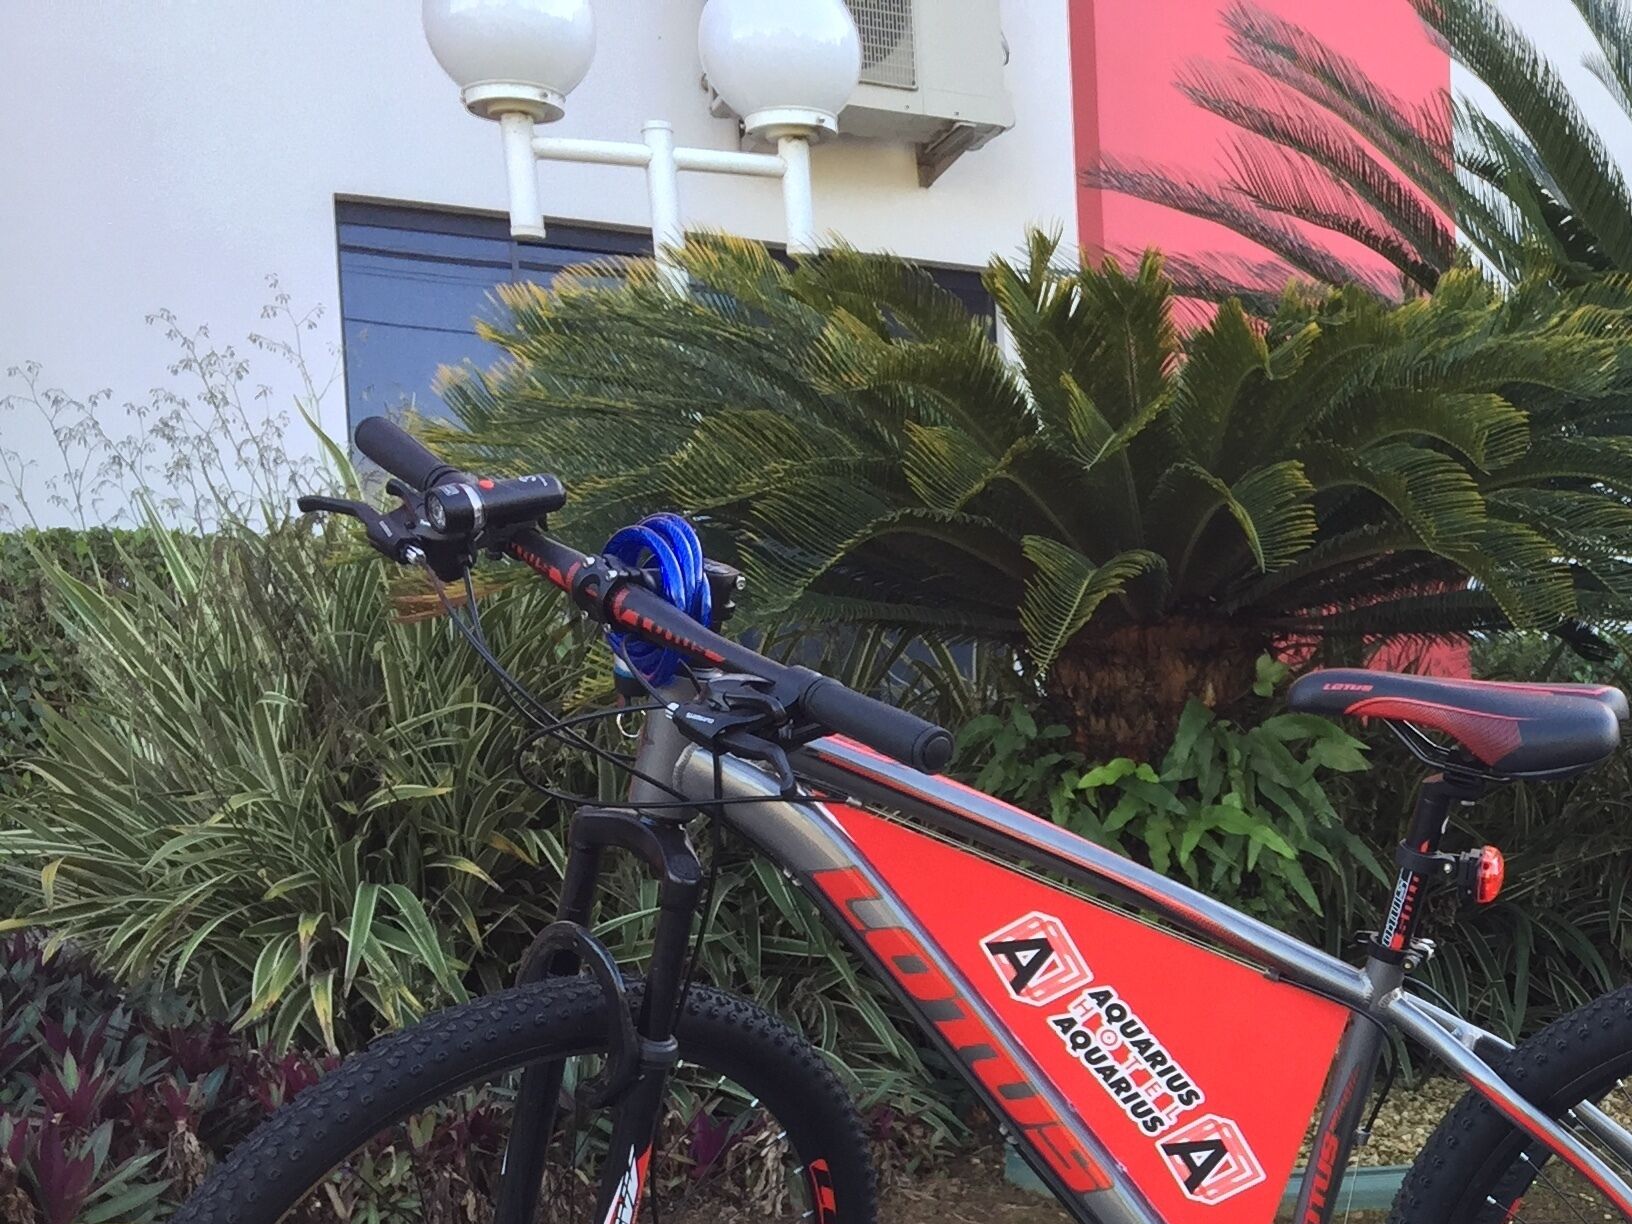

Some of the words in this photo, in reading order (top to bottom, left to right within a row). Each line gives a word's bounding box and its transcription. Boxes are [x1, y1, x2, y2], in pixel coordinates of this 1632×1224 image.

[1322, 682, 1373, 692] LOTUS
[812, 866, 1115, 1193] LOTUS
[1052, 1016, 1164, 1133] AQUARIUS
[1072, 999, 1179, 1121] HOTEL
[1087, 989, 1201, 1107] AQUARIUS
